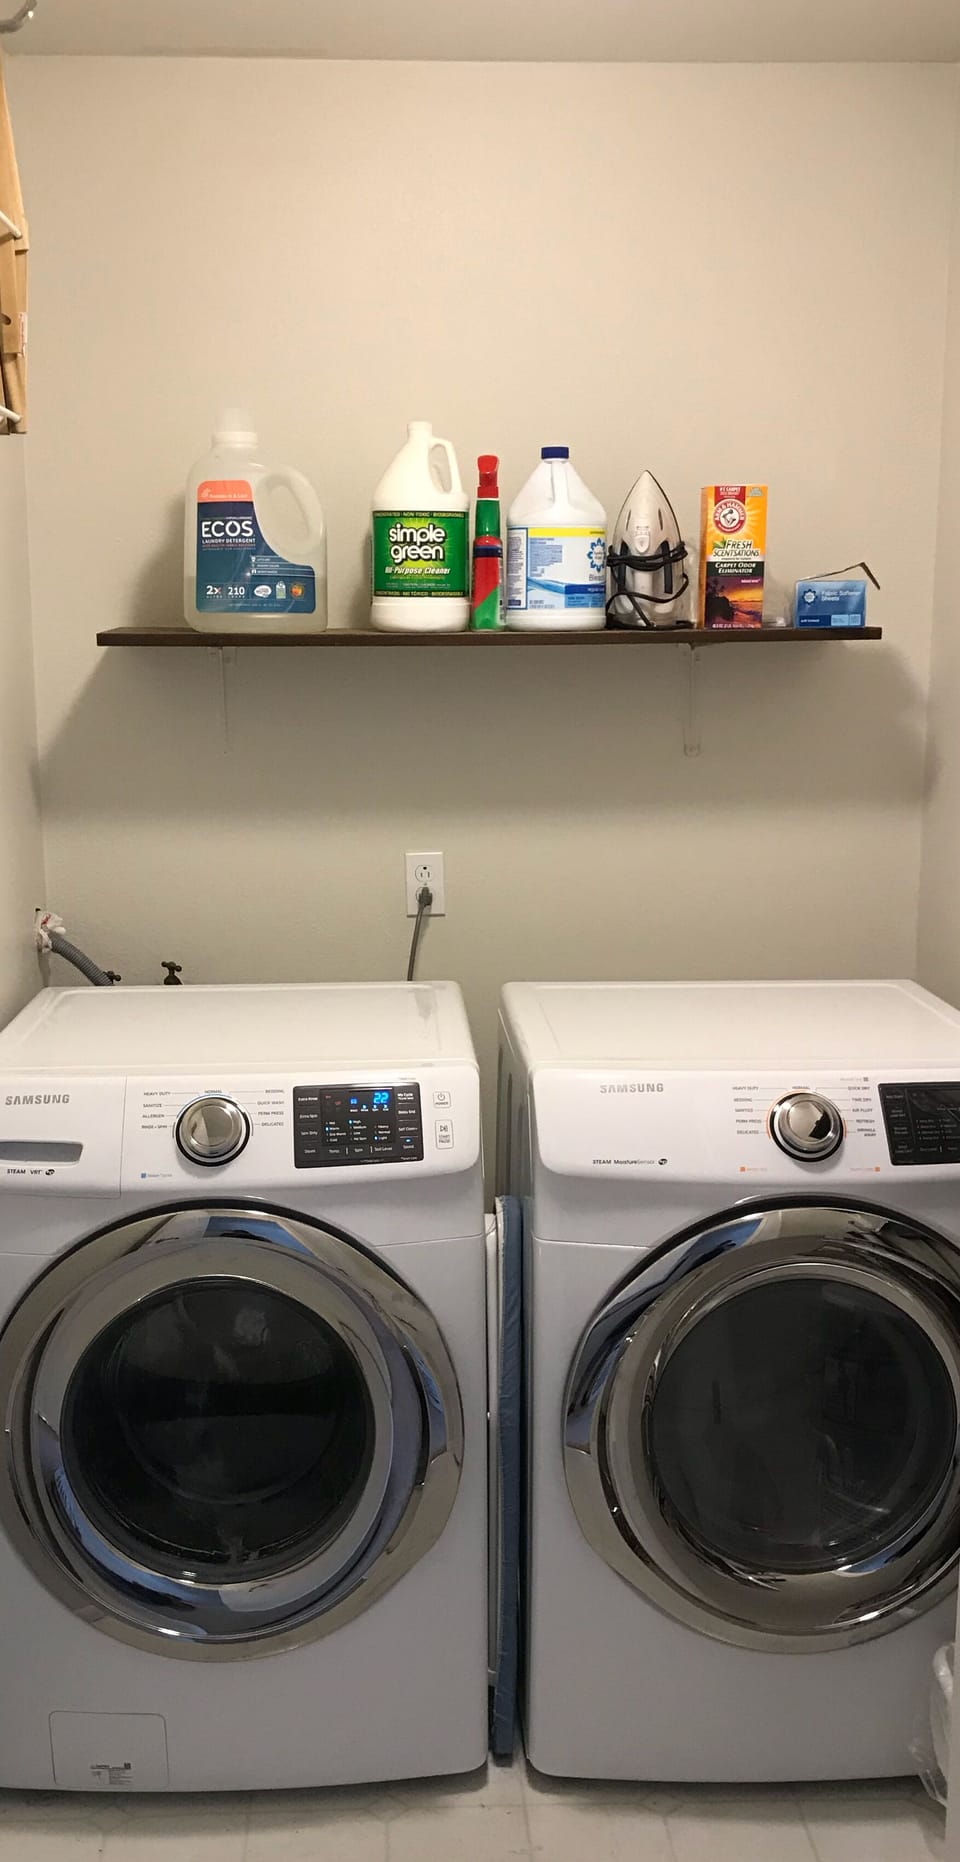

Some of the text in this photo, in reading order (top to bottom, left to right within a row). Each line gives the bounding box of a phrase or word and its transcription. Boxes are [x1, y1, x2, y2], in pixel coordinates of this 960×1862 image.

[202, 521, 254, 538] ECOS
[389, 523, 446, 546] simple
[726, 540, 753, 550] FRESH
[390, 545, 444, 564] green
[424, 567, 451, 575] Cleaner
[227, 586, 246, 596] 210
[599, 1083, 664, 1094] SAMSUNG
[5, 1094, 70, 1106] SAMSUNG
[373, 1092, 389, 1104] 22
